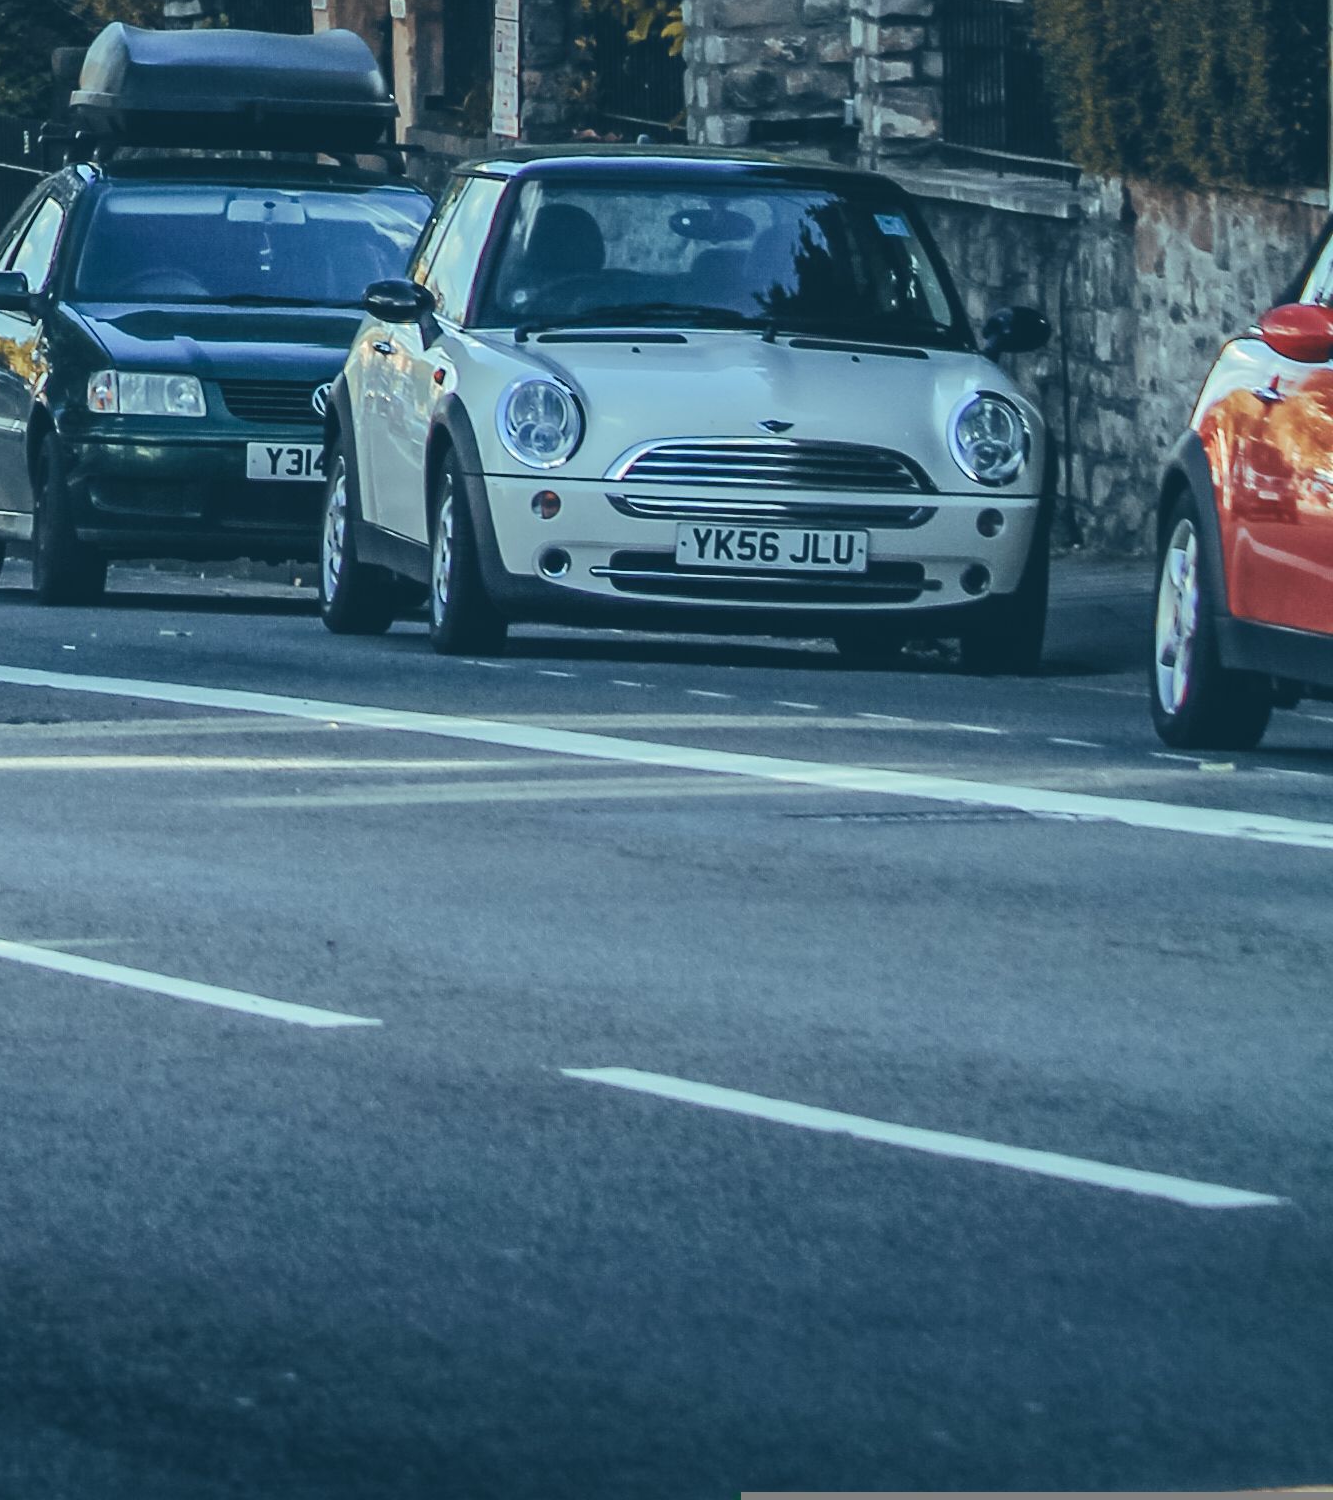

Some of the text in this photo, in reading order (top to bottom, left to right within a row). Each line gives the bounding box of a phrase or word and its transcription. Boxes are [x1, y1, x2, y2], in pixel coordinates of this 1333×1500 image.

[266, 447, 326, 477] Y314
[693, 527, 855, 565] YK56 JLU
